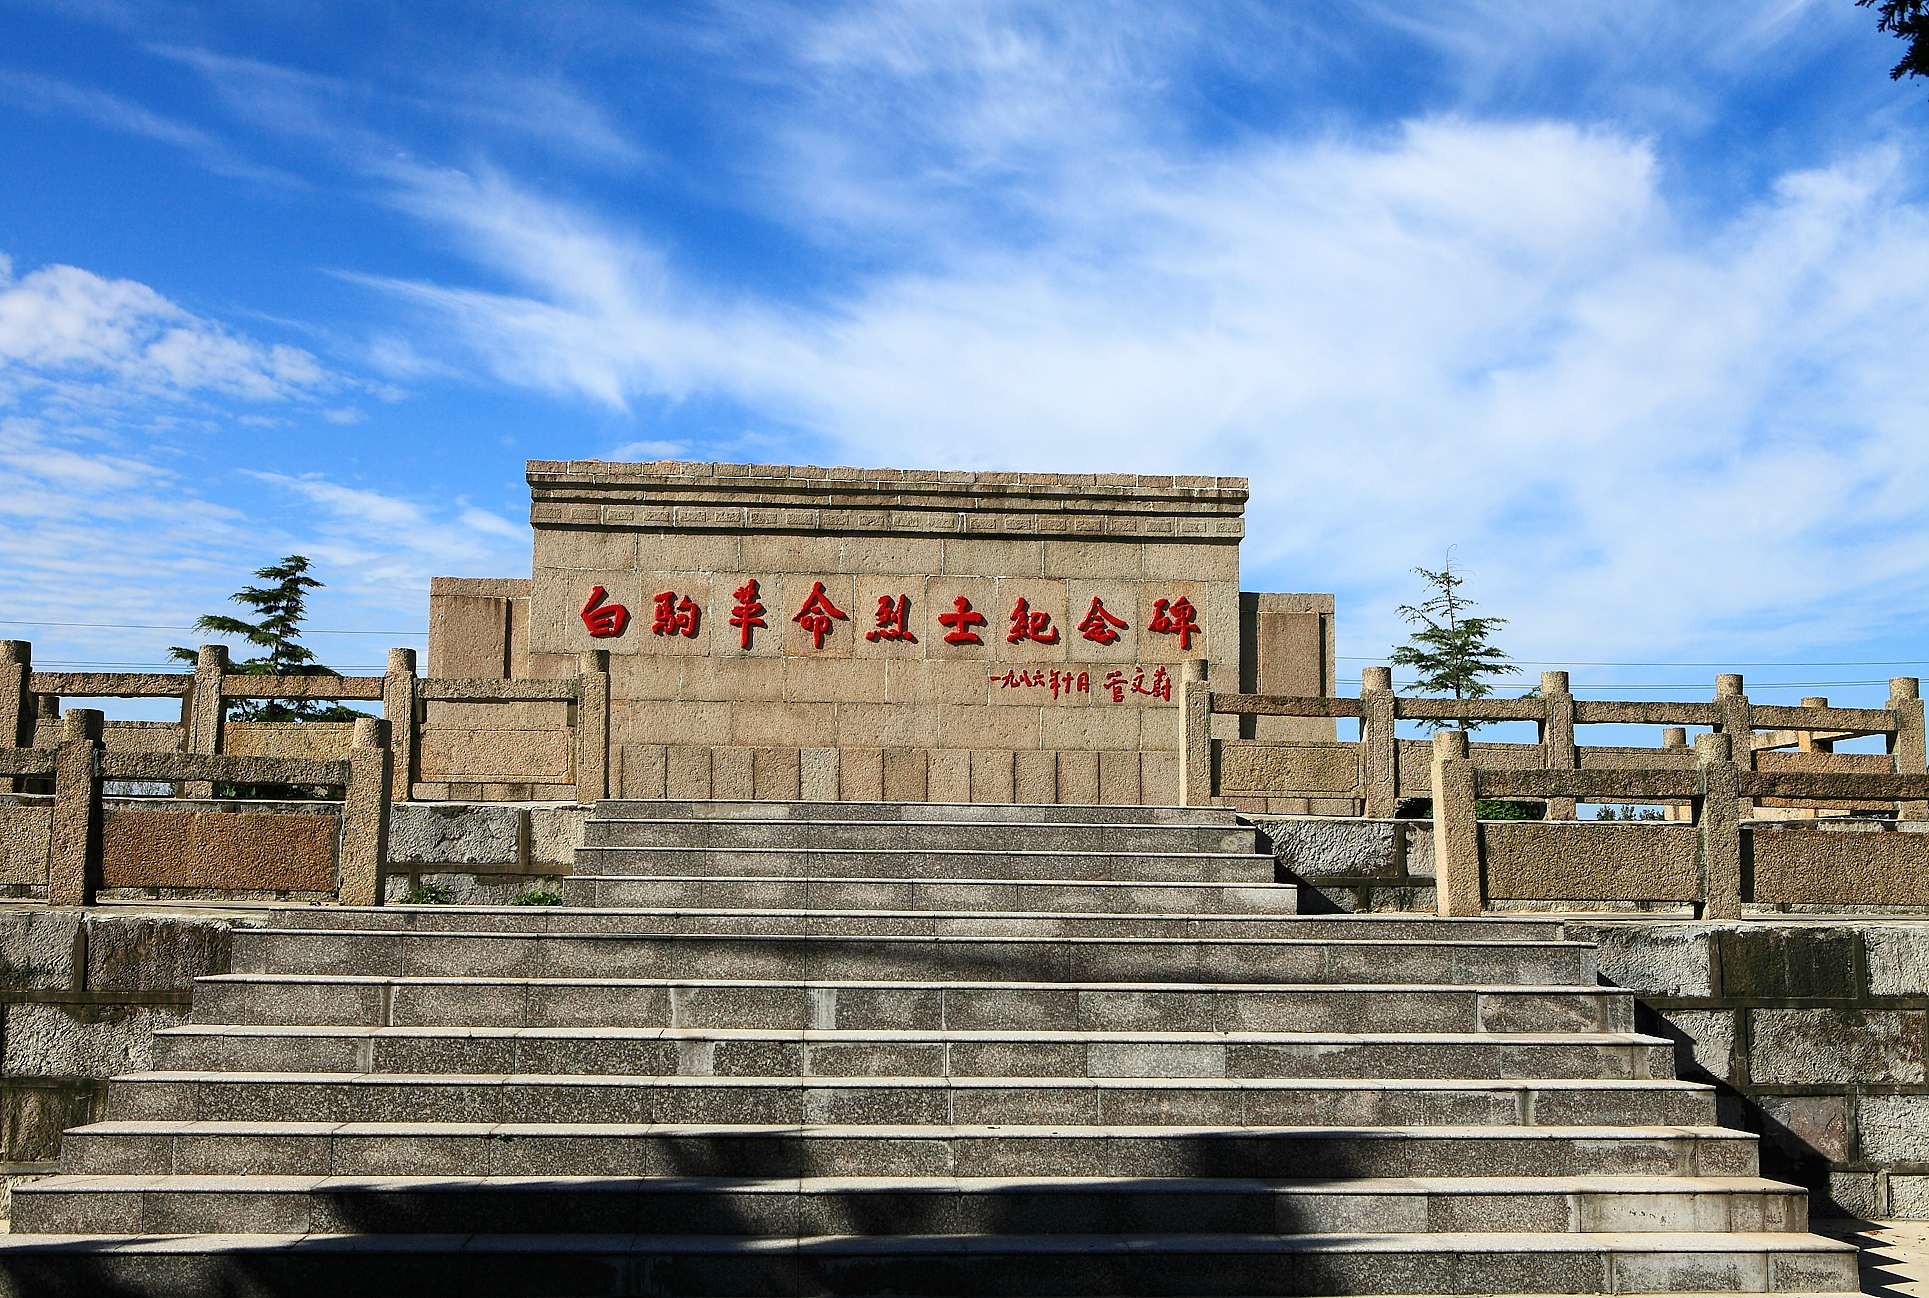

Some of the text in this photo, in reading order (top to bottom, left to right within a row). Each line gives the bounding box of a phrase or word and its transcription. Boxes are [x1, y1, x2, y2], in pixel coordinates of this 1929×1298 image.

[990, 668, 1090, 700] 一九八六年十月
